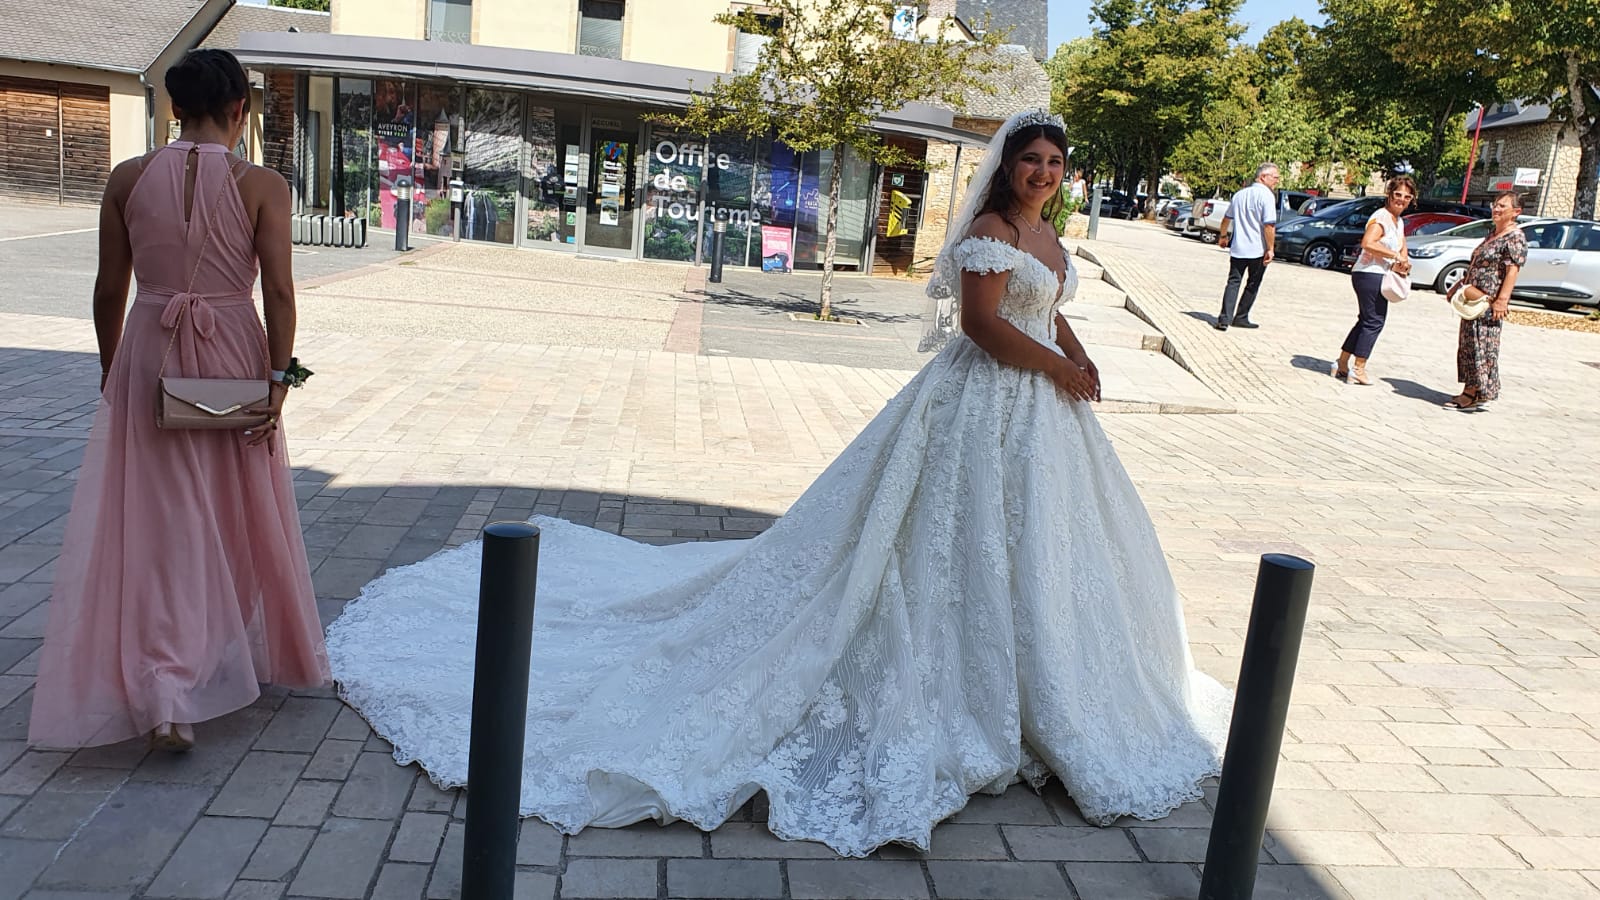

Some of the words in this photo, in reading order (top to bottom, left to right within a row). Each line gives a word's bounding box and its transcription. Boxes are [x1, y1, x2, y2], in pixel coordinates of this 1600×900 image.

[378, 123, 408, 132] AVEYRON
[655, 140, 730, 170] Office
[653, 168, 687, 192] de
